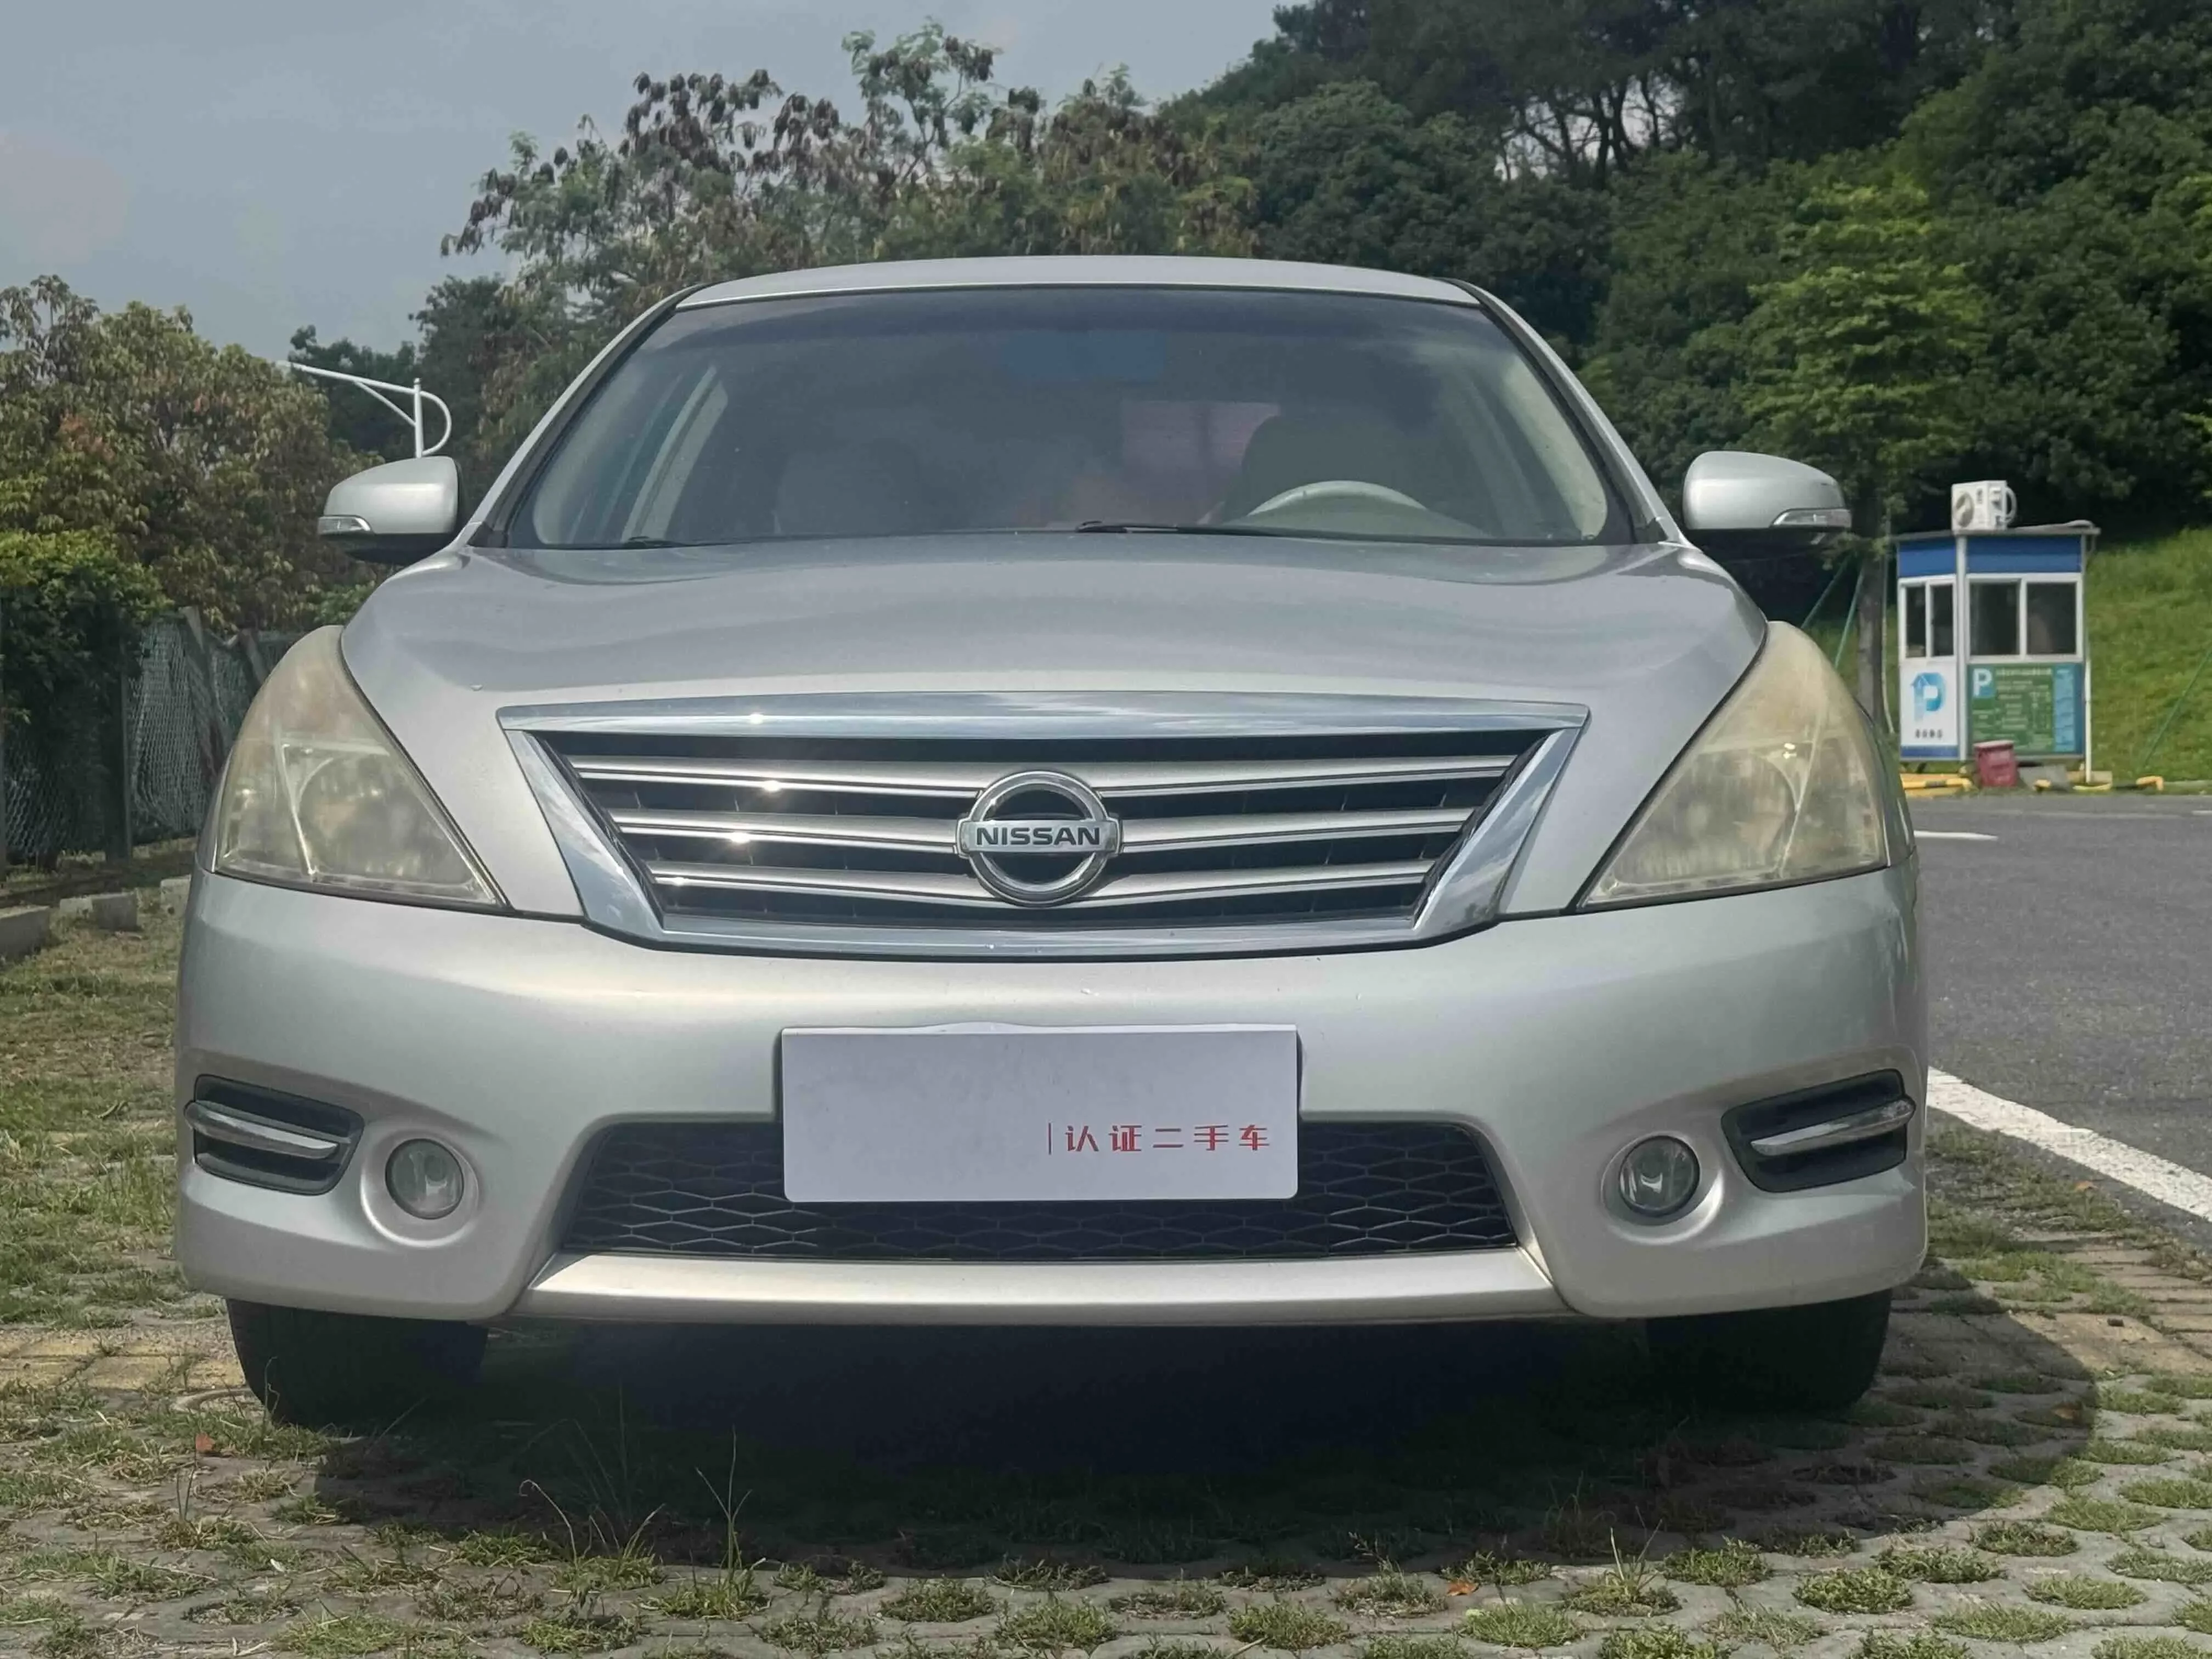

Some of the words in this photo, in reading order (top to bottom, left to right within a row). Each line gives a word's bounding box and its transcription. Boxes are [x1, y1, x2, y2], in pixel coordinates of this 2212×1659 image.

[1973, 668, 1993, 696] P
[977, 827, 1099, 845] NISSAN
[1065, 1124, 1269, 1152] 认证二手车
